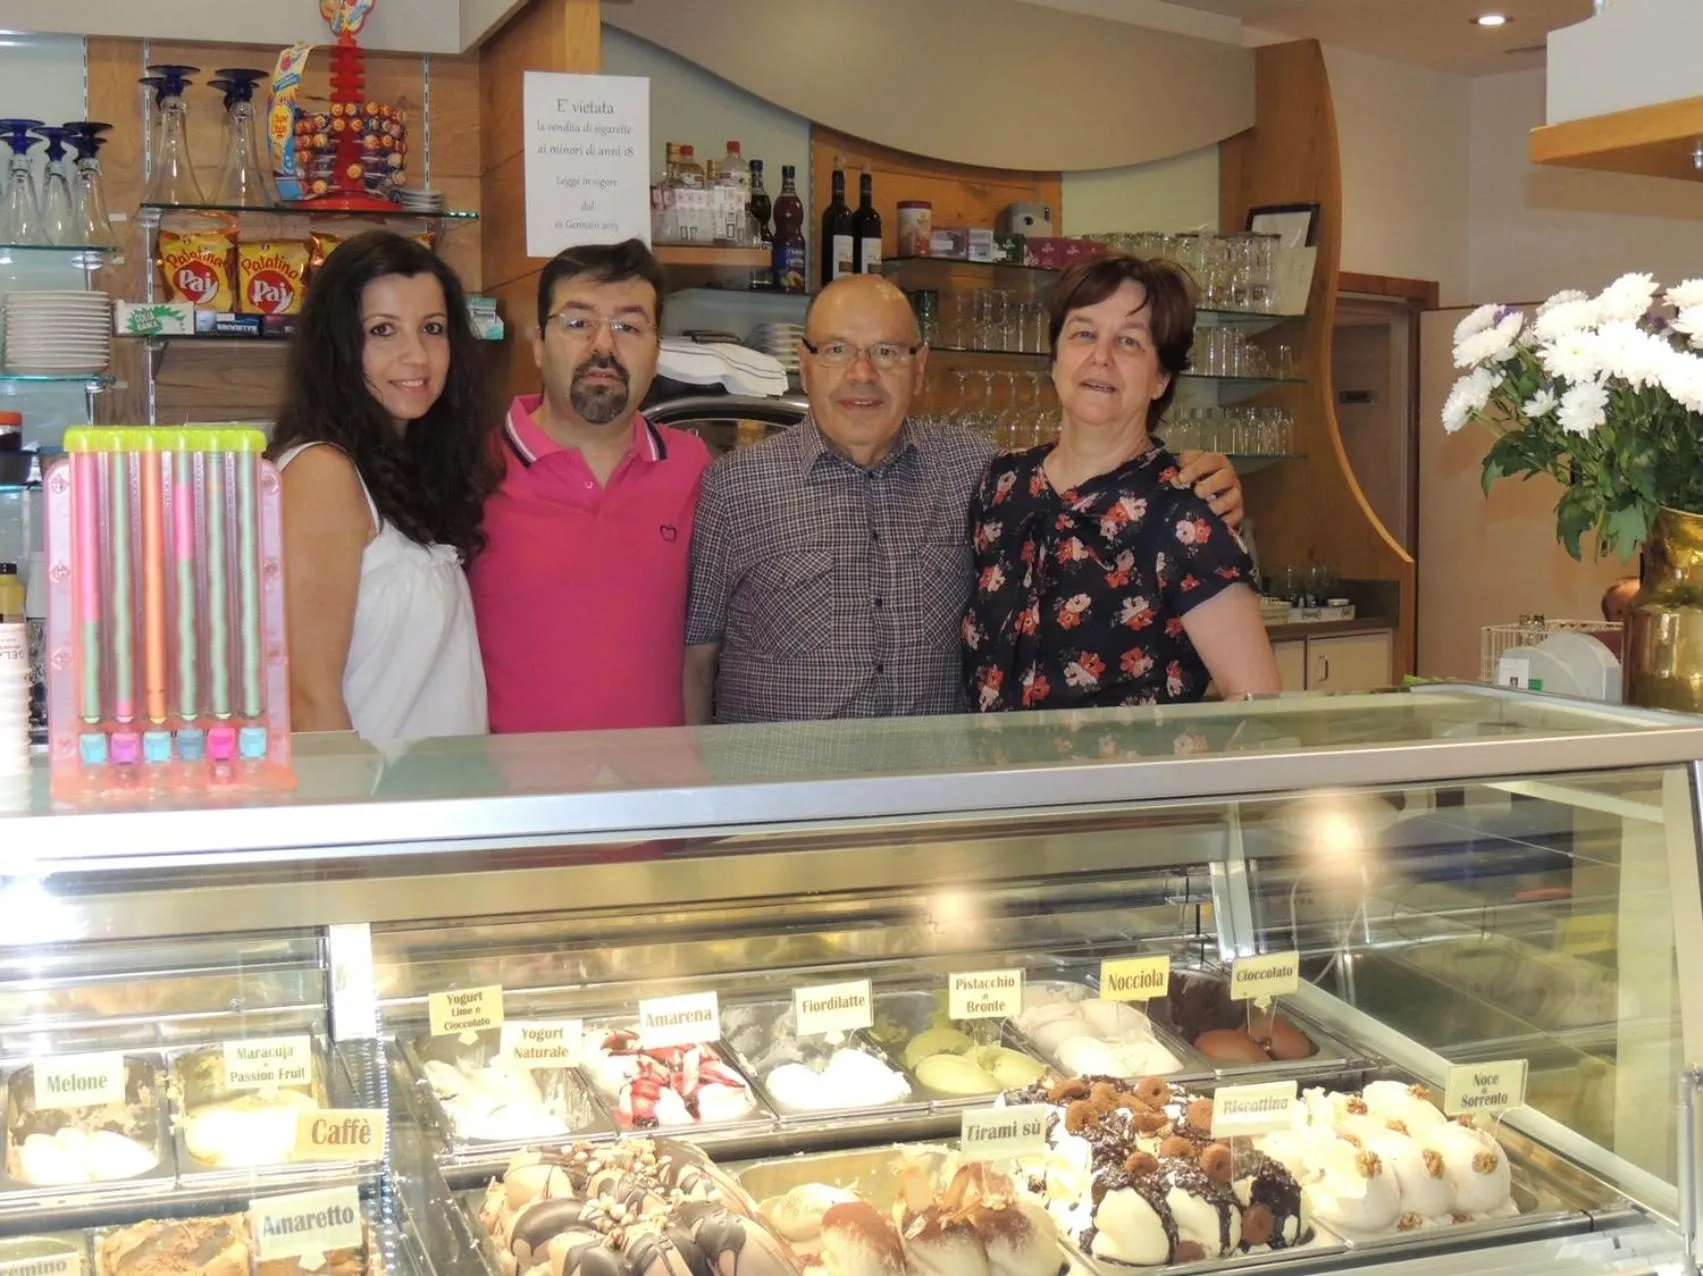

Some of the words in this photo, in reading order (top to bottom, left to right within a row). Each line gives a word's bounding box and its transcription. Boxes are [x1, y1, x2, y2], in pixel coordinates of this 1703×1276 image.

[572, 101, 615, 115] vietata
[537, 120, 545, 132] la
[548, 121, 580, 133] vendita
[583, 122, 592, 133] di
[537, 144, 547, 154] ai
[550, 144, 582, 155] minori
[585, 145, 596, 156] di
[598, 146, 621, 157] anni
[581, 201, 595, 211] dal
[564, 219, 599, 230] Gennaio
[166, 246, 223, 268] Palatina
[241, 254, 300, 280] Palatina
[1108, 968, 1165, 992] Nocciola
[1236, 964, 1294, 982] Cioccolato
[955, 974, 1016, 991] Pistacchio
[446, 991, 484, 1006] Yogurt
[802, 994, 866, 1013] Fiordilatte
[451, 1008, 473, 1017] Lime
[966, 1000, 1006, 1014] Bronte
[444, 1018, 491, 1031] Cioccolato
[645, 1007, 713, 1029] Amarena
[521, 1027, 565, 1043] Yogurt
[236, 1044, 294, 1060] Maracuja
[513, 1046, 570, 1060] Naturale
[46, 1073, 109, 1093] Melone
[229, 1072, 275, 1083] Passion
[278, 1067, 306, 1081] Fruit
[1472, 1073, 1500, 1087] Noce
[1460, 1092, 1509, 1109] Sorrento
[311, 1117, 372, 1146] Caffè
[965, 1120, 1018, 1141] Tirami
[1022, 1117, 1042, 1136] sù
[263, 1204, 354, 1237] Amaretto
[0, 1260, 68, 1276] remino
